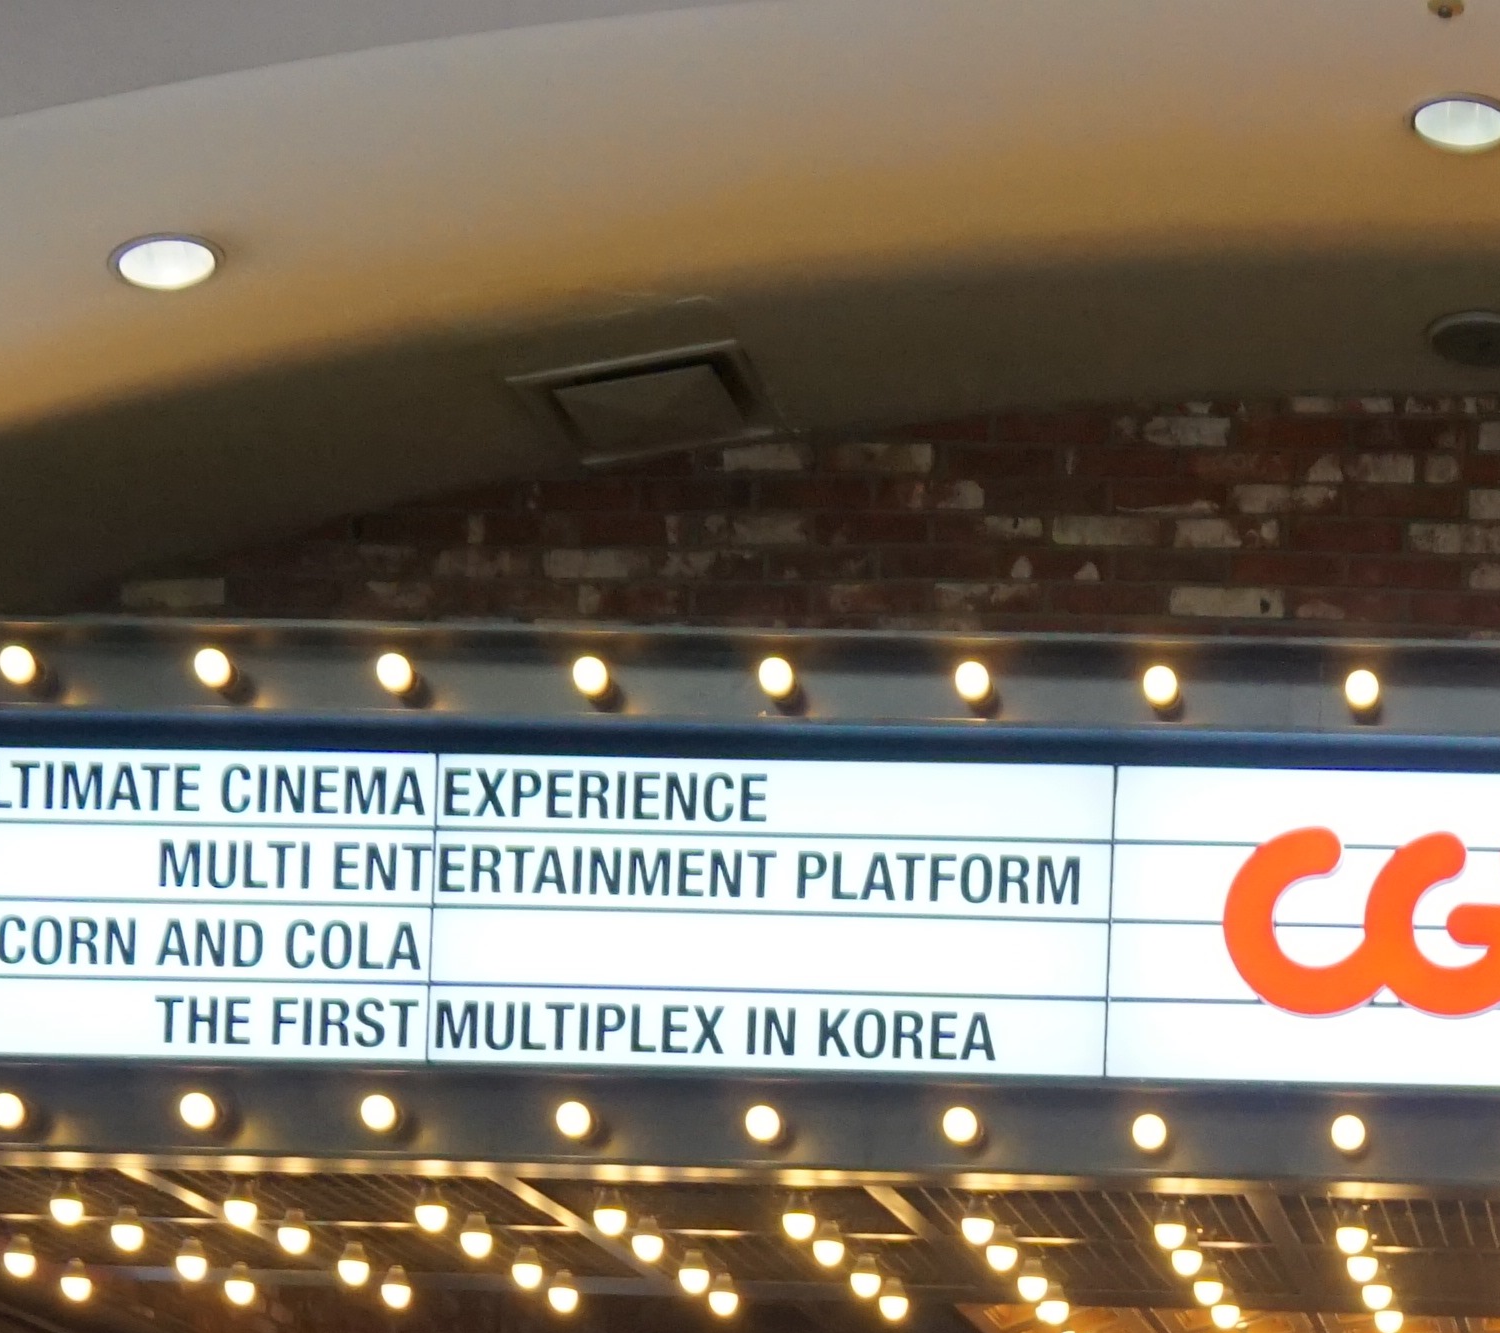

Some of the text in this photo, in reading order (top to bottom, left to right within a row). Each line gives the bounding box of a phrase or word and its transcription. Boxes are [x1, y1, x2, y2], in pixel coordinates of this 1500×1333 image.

[221, 766, 425, 816] CINEMA
[443, 768, 767, 822] EXPERIENCE
[159, 842, 1080, 905] MULTI ENTERTAINMENT PLATFORM
[157, 921, 263, 968] AND
[286, 922, 421, 970] COLA
[155, 997, 996, 1061] THE FIRST MULTIPLEX IN KOREA
